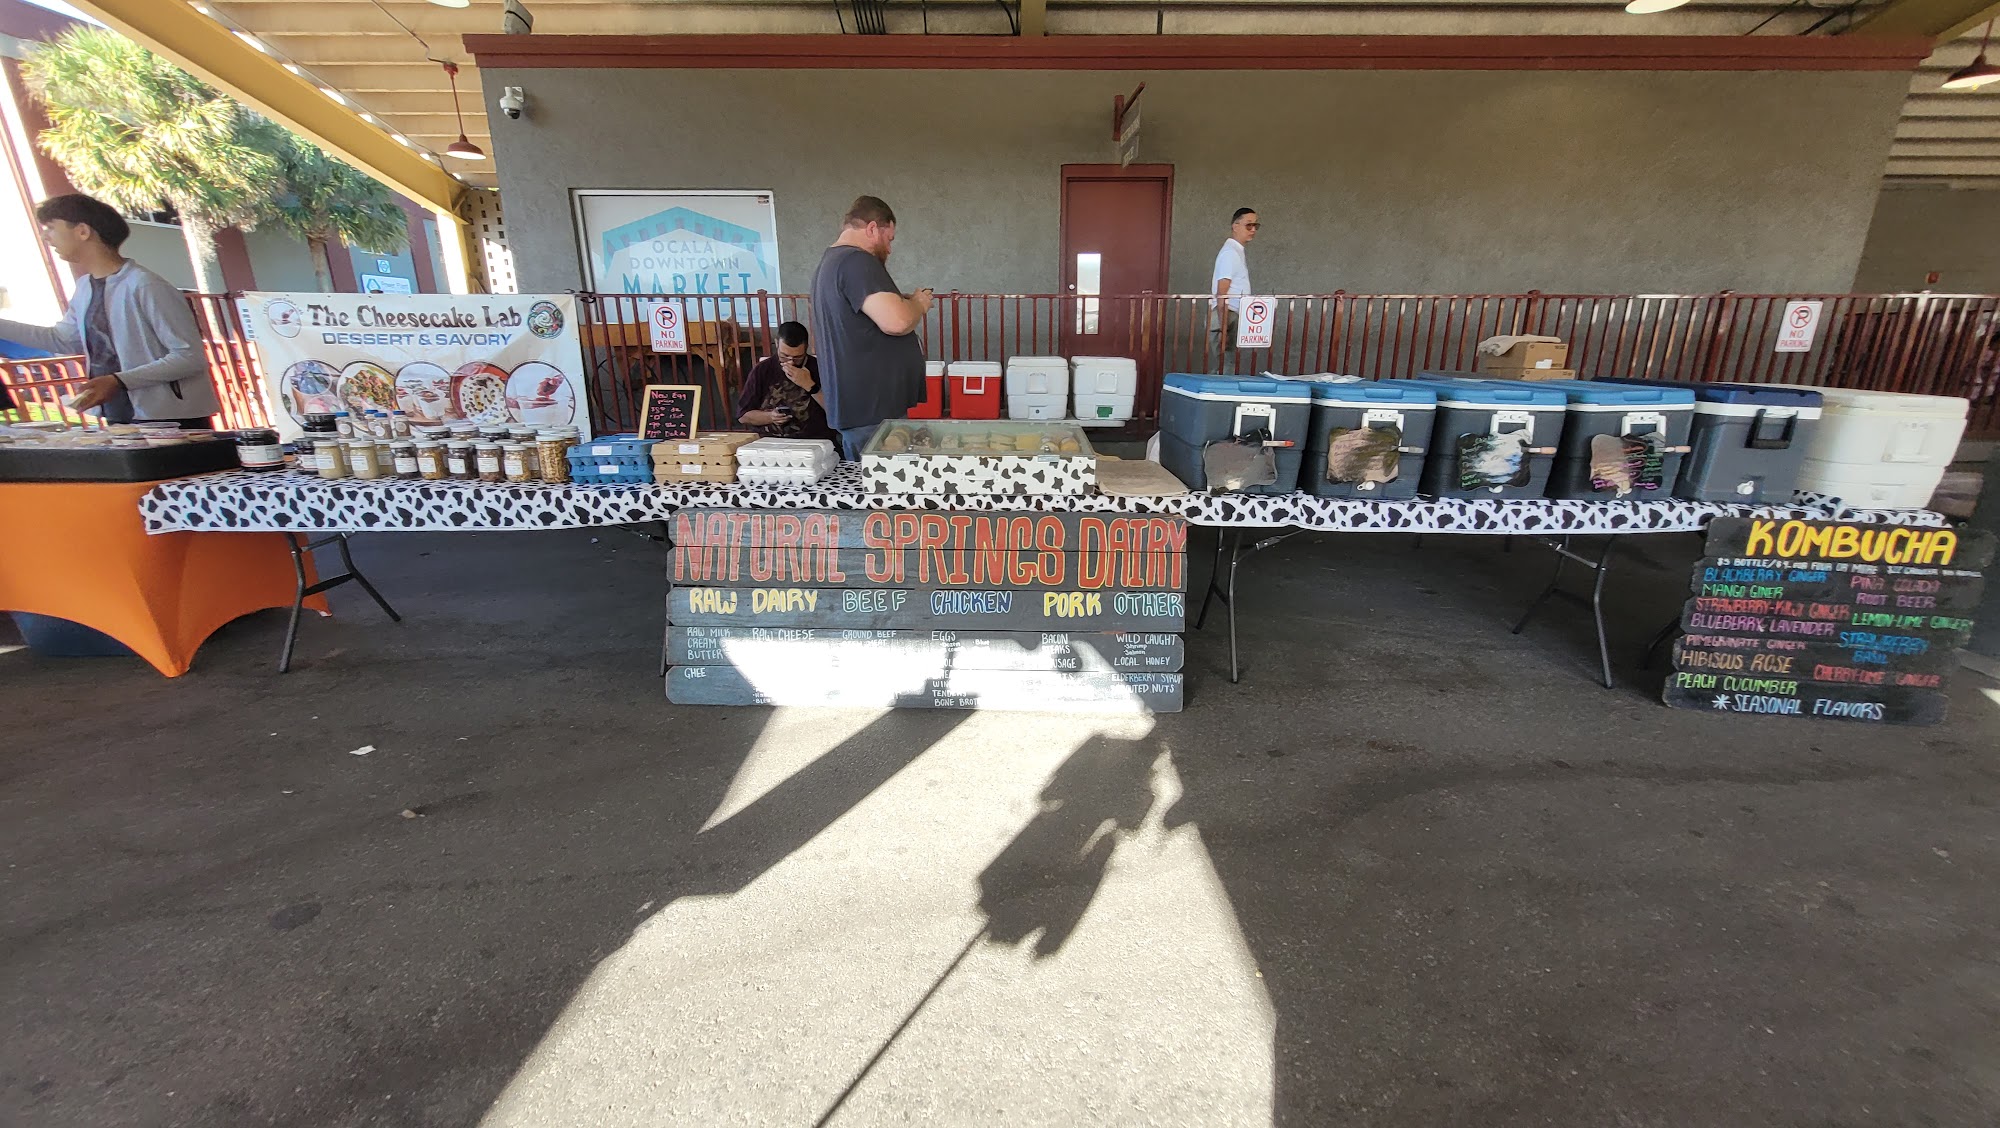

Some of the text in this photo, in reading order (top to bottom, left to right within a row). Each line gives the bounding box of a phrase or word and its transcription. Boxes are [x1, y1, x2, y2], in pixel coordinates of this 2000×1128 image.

[652, 240, 714, 254] OCALA
[630, 257, 740, 270] DOWNTOWN
[623, 272, 752, 303] MARKET
[307, 304, 350, 327] The
[356, 304, 478, 328] Cheesecake
[481, 305, 523, 328] Lab
[660, 330, 675, 339] NO
[1248, 325, 1263, 334] NO
[1789, 330, 1805, 338] NO
[322, 332, 513, 346] DESSERT & SAVORY
[655, 340, 683, 349] PARKING
[1240, 335, 1269, 343] PARKING
[1745, 519, 1958, 566] KOMBUCHA
[674, 512, 1187, 589] NATURAL SPRINGS DAIRY
[1703, 567, 1783, 582] BLACKBERRY
[1701, 584, 1746, 598] MANGO
[689, 588, 1184, 618] RAW DAIRY BEEF CHICKEN PORK OTHER
[1856, 592, 1937, 608] ROOT BEER
[1690, 612, 1835, 636] BLUEBERRY LAVENDER
[687, 627, 731, 638] RAW MILK
[752, 627, 815, 642] RAW CHEESE
[842, 629, 897, 641] GROUND BEEF
[931, 630, 956, 642] EGGS
[1041, 632, 1069, 645] BACON
[687, 637, 717, 649] CREAM
[1116, 633, 1178, 646] WILD CAUGHT
[687, 649, 724, 660] BUTTER
[1042, 644, 1071, 654] EAKS
[1114, 656, 1171, 666] LOCAL HONEY
[1680, 649, 1794, 674] HIBISCUS ROSE
[684, 667, 707, 679] GHEE
[1111, 673, 1184, 685] ELDERBERRY SYRUP
[1151, 683, 1175, 694] NUTS
[1676, 672, 1798, 696] PEACH CUCUMBER
[934, 698, 978, 707] BONE BROT
[1731, 693, 1887, 720] SEASONAL FLAVORS
